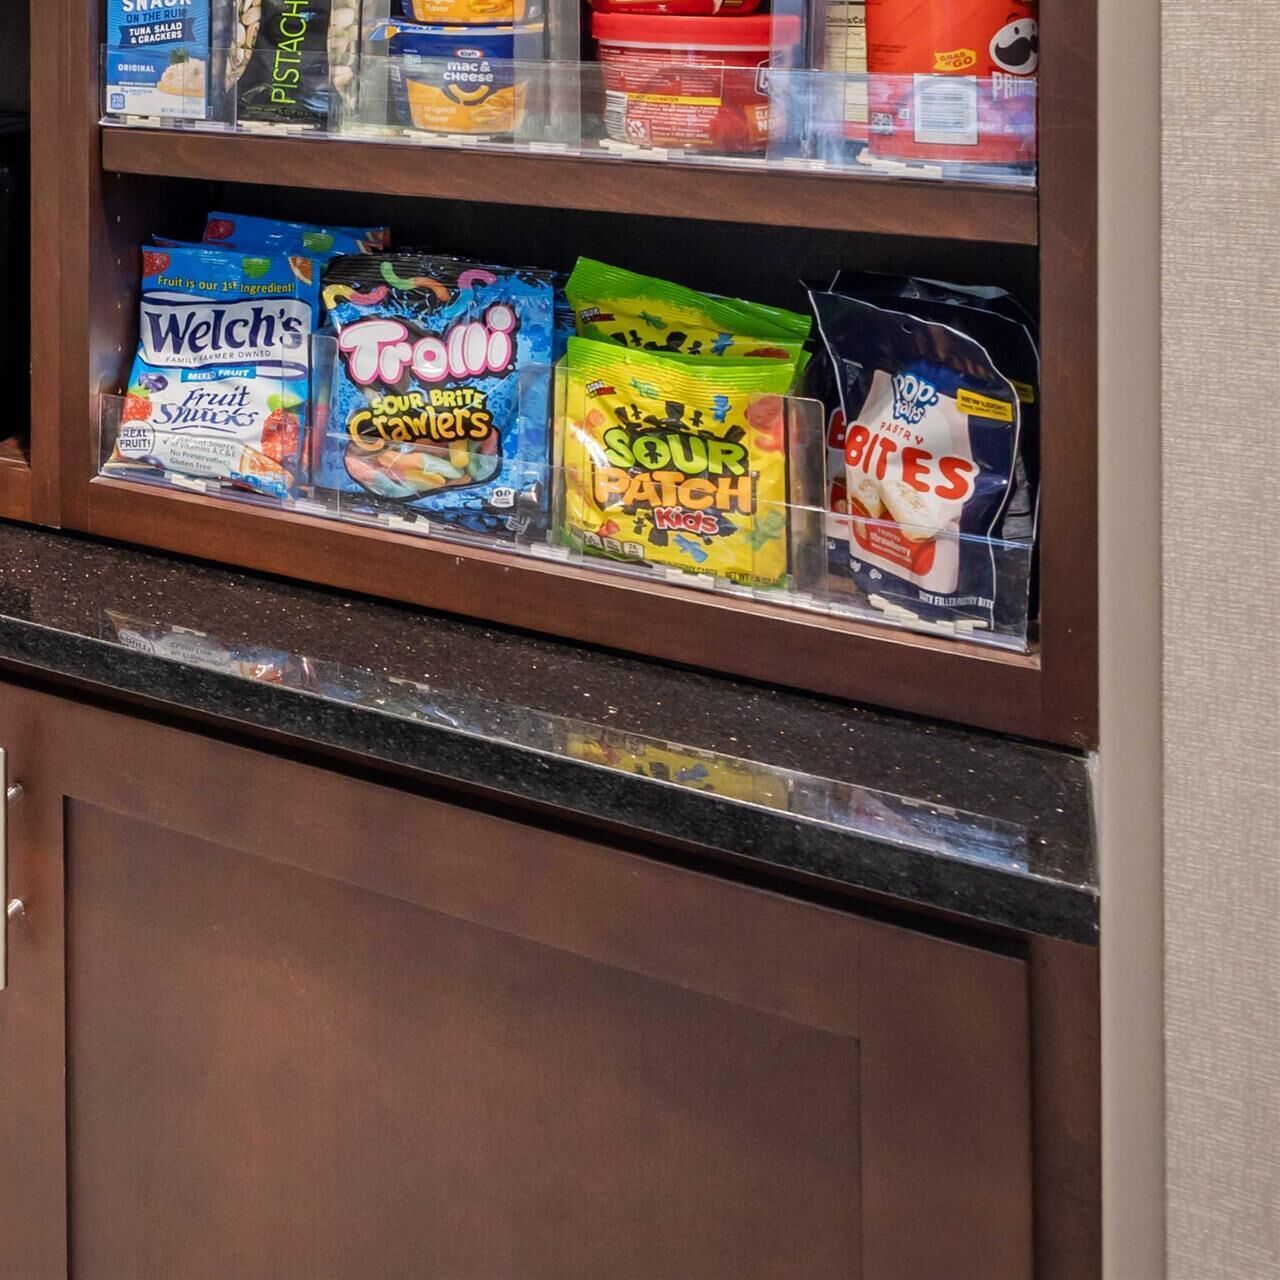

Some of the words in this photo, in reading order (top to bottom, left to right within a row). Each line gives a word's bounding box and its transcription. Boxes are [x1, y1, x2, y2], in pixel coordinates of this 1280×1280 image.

[129, 27, 151, 36] TUNA
[154, 23, 182, 33] SALAD
[138, 31, 182, 43] CRACKERS
[118, 64, 155, 73] ORIGINAL
[157, 276, 183, 287] Fruit
[186, 279, 195, 289] is
[199, 280, 218, 290] our
[222, 281, 236, 291] 1st
[240, 283, 295, 294] Ingredient!
[146, 307, 303, 352] Welch's
[341, 306, 516, 382] Trolli
[184, 386, 249, 407] Fruit
[373, 392, 422, 414] SOUR
[432, 390, 485, 408] BRITE
[151, 404, 259, 426] Snacks
[352, 408, 490, 450] Crawlers
[879, 421, 923, 445] PASTRY
[604, 428, 747, 475] SOUR
[845, 425, 978, 498] BITES
[593, 471, 752, 511] PATCH
[655, 508, 718, 534] Kids
